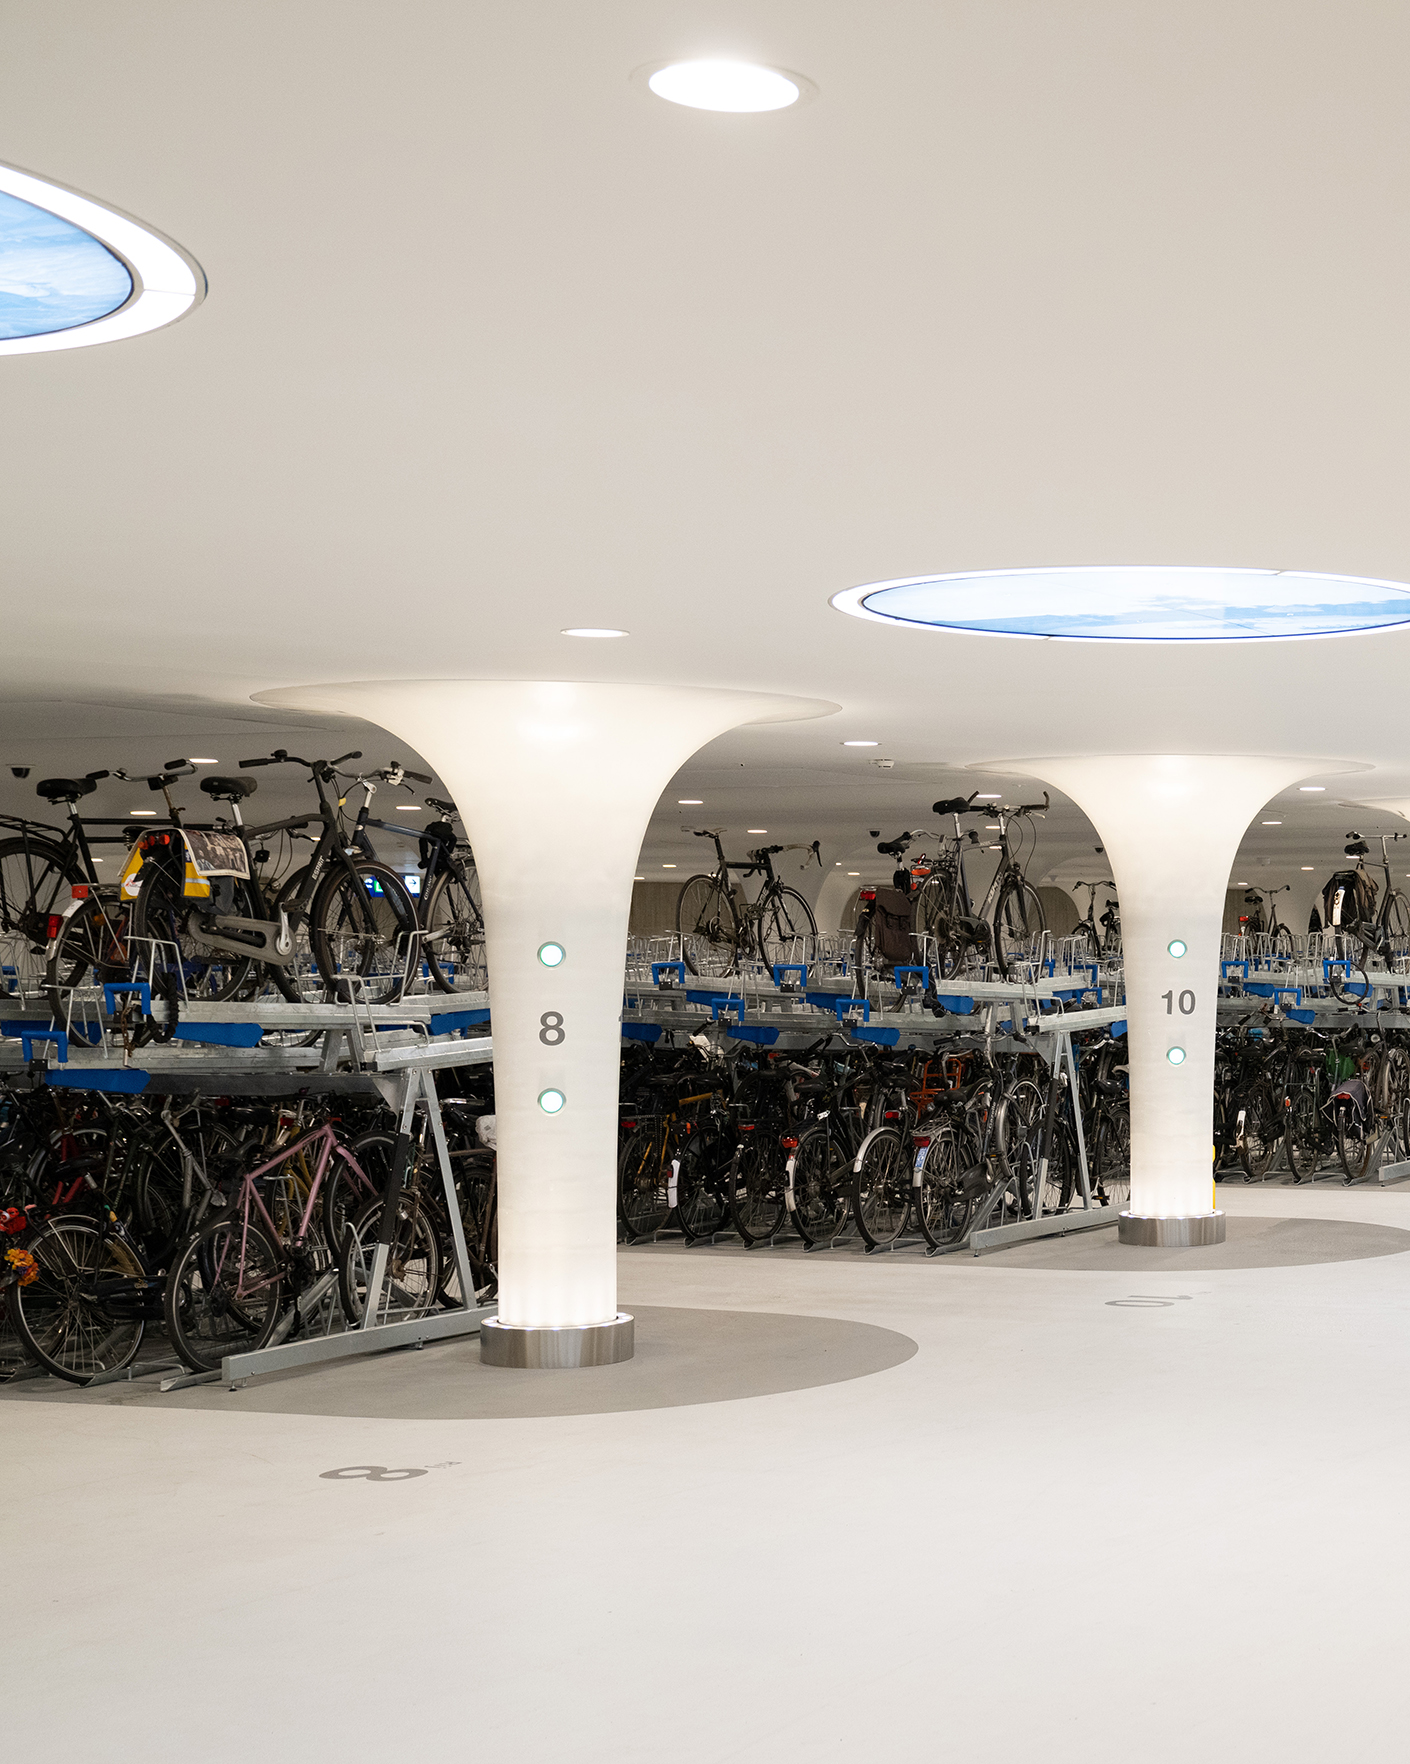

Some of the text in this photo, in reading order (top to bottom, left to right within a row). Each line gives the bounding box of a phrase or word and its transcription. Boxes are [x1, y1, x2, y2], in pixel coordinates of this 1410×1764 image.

[311, 855, 325, 881] ESPRIT
[1161, 988, 1197, 1016] 10
[538, 1010, 566, 1047] 8
[318, 1465, 429, 1482] 8
